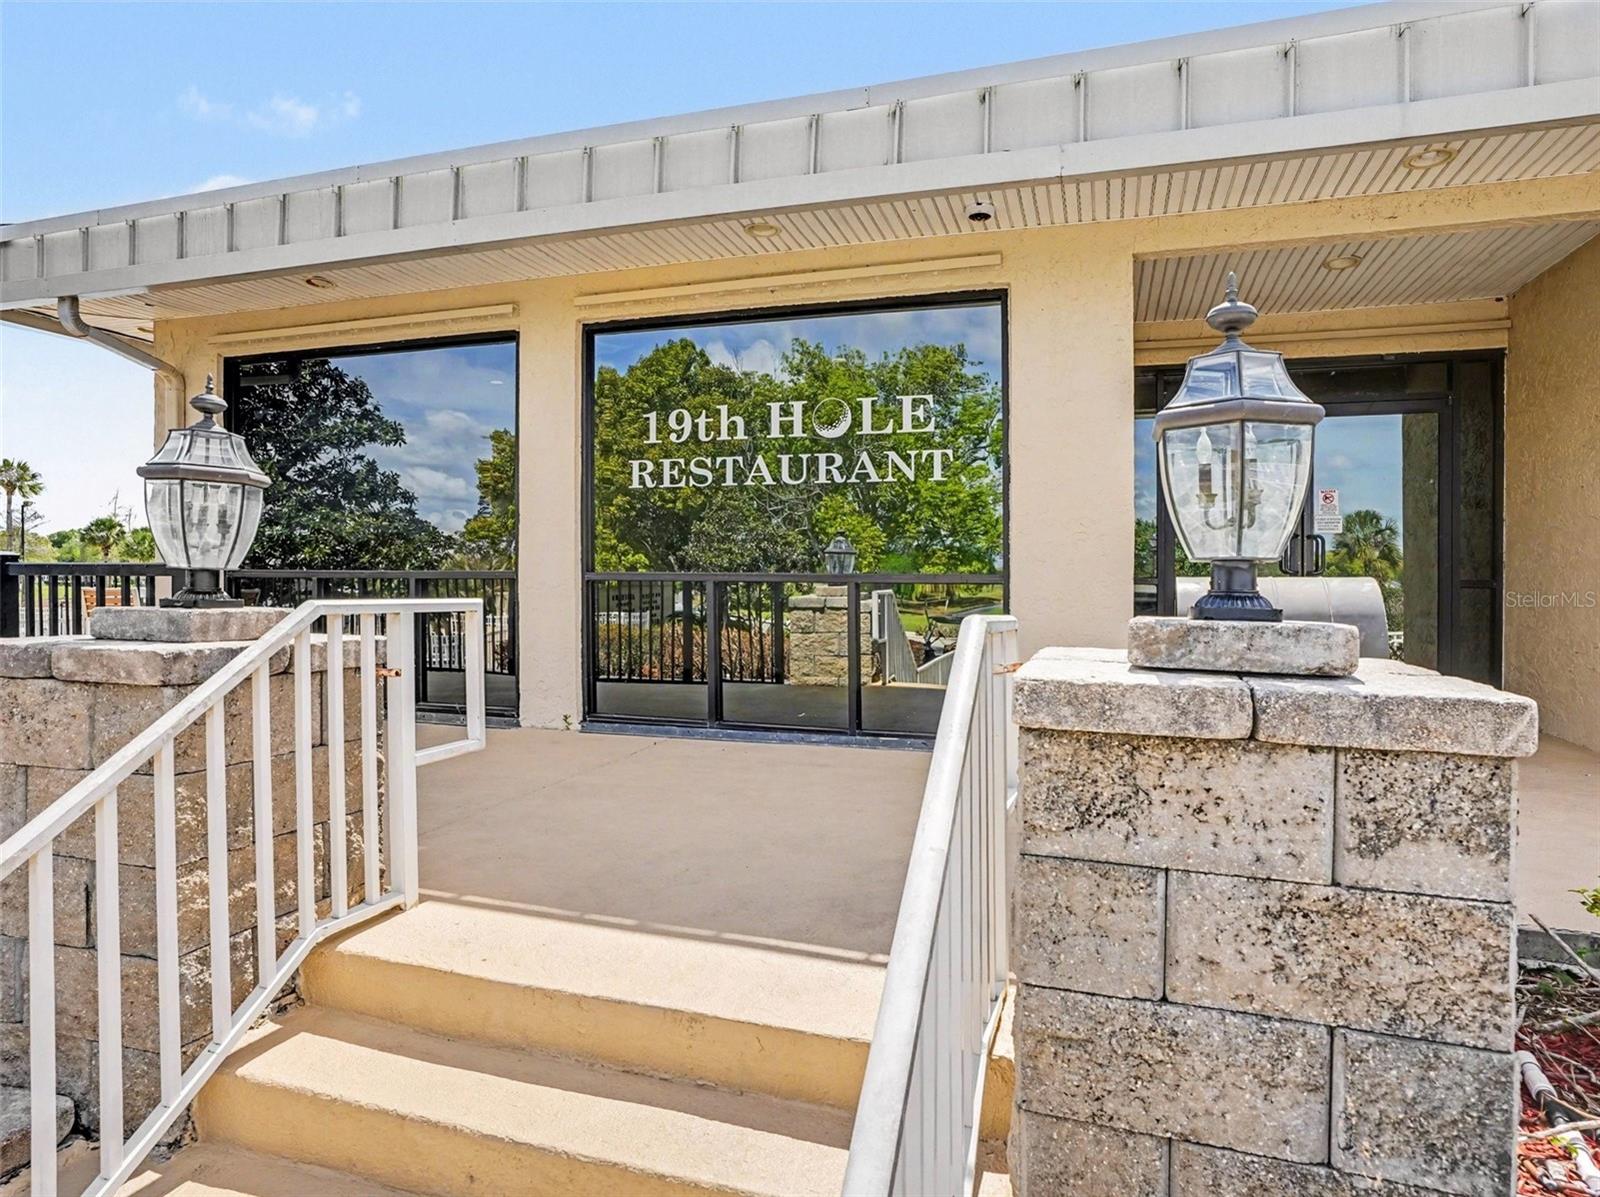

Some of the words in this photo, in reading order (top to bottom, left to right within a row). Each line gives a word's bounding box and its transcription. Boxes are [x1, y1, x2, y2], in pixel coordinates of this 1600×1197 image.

[642, 404, 748, 444] 19th
[766, 394, 936, 439] HOLE
[628, 449, 954, 489] RESTAURANT
